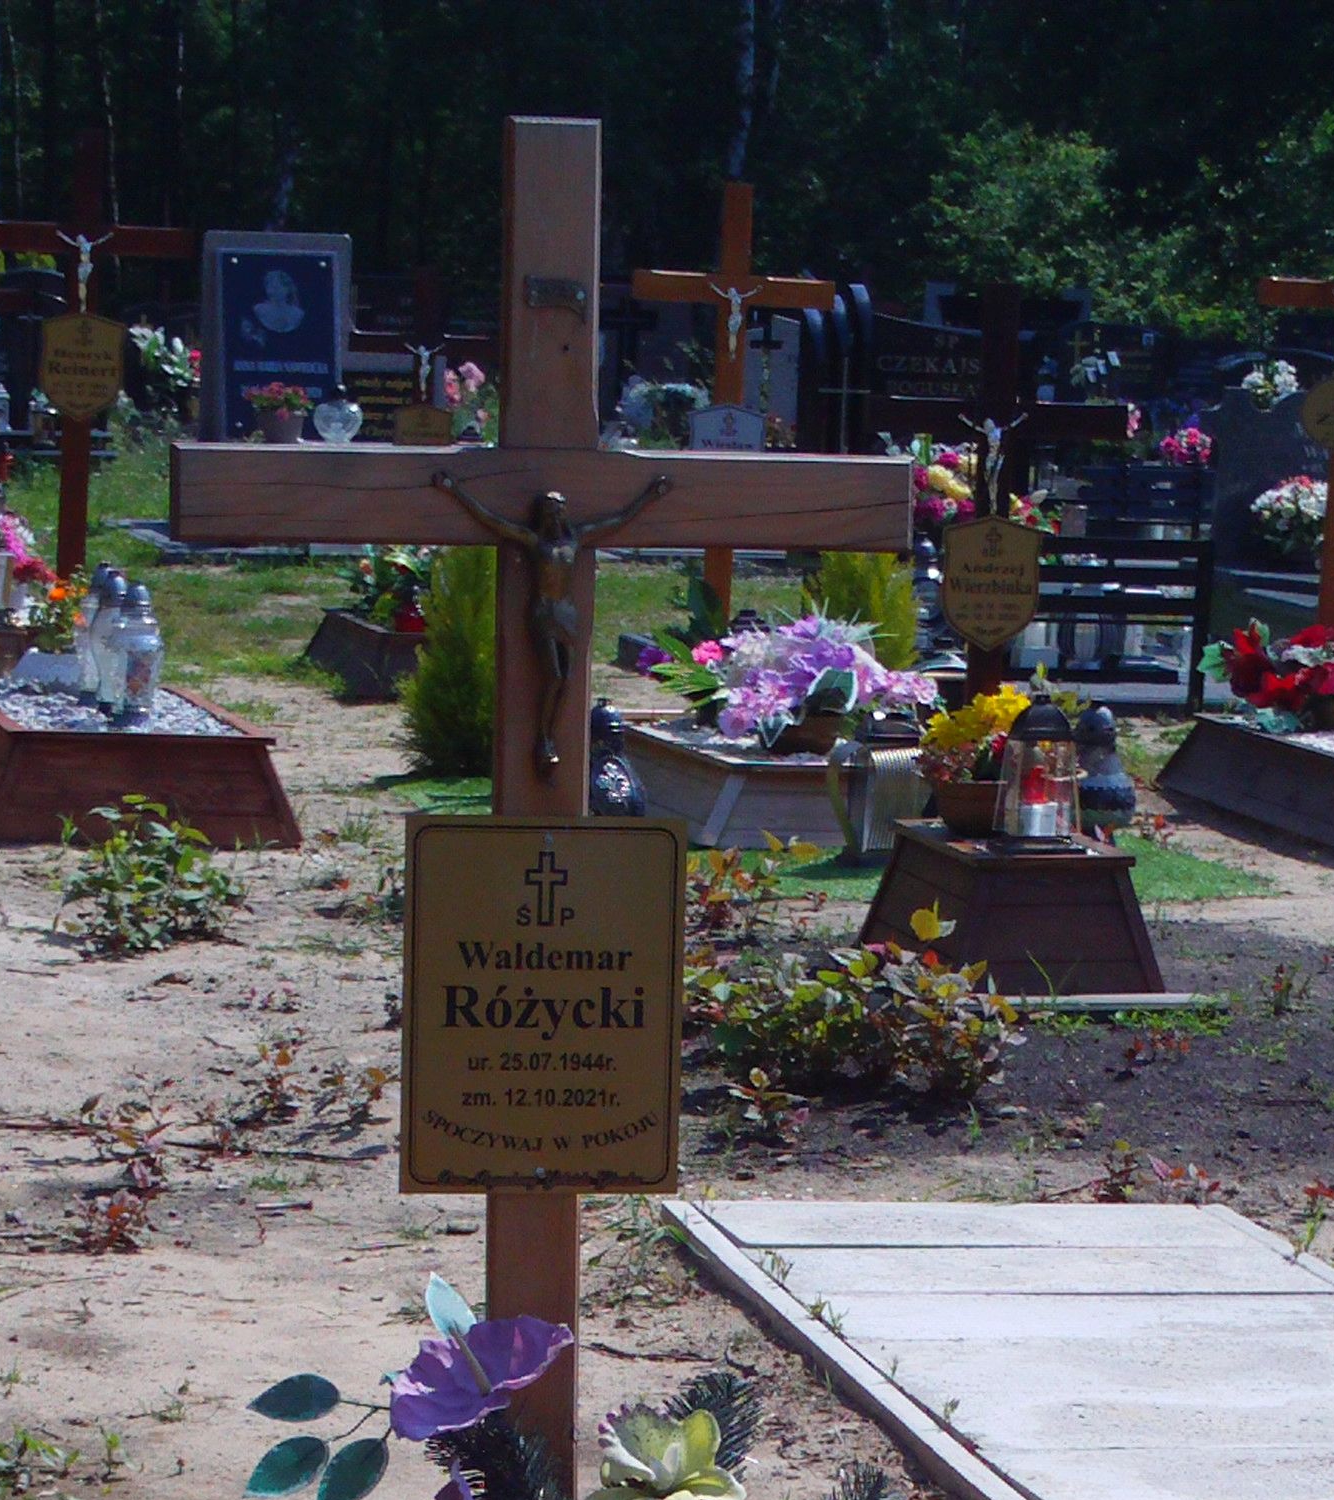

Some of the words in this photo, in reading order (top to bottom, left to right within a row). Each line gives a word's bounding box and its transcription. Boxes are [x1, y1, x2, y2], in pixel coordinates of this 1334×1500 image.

[559, 906, 575, 927] P
[456, 940, 634, 972] Waldemar
[441, 984, 645, 1041] Różycki
[467, 1055, 493, 1071] ur.
[499, 1052, 618, 1072] 25.07.1944r.
[461, 1091, 497, 1107] zm.
[504, 1088, 621, 1107] 12.10.2021r.
[423, 1109, 543, 1152] SPOCZYWAJ
[553, 1136, 572, 1150] W
[581, 1110, 659, 1149] POKOJU
